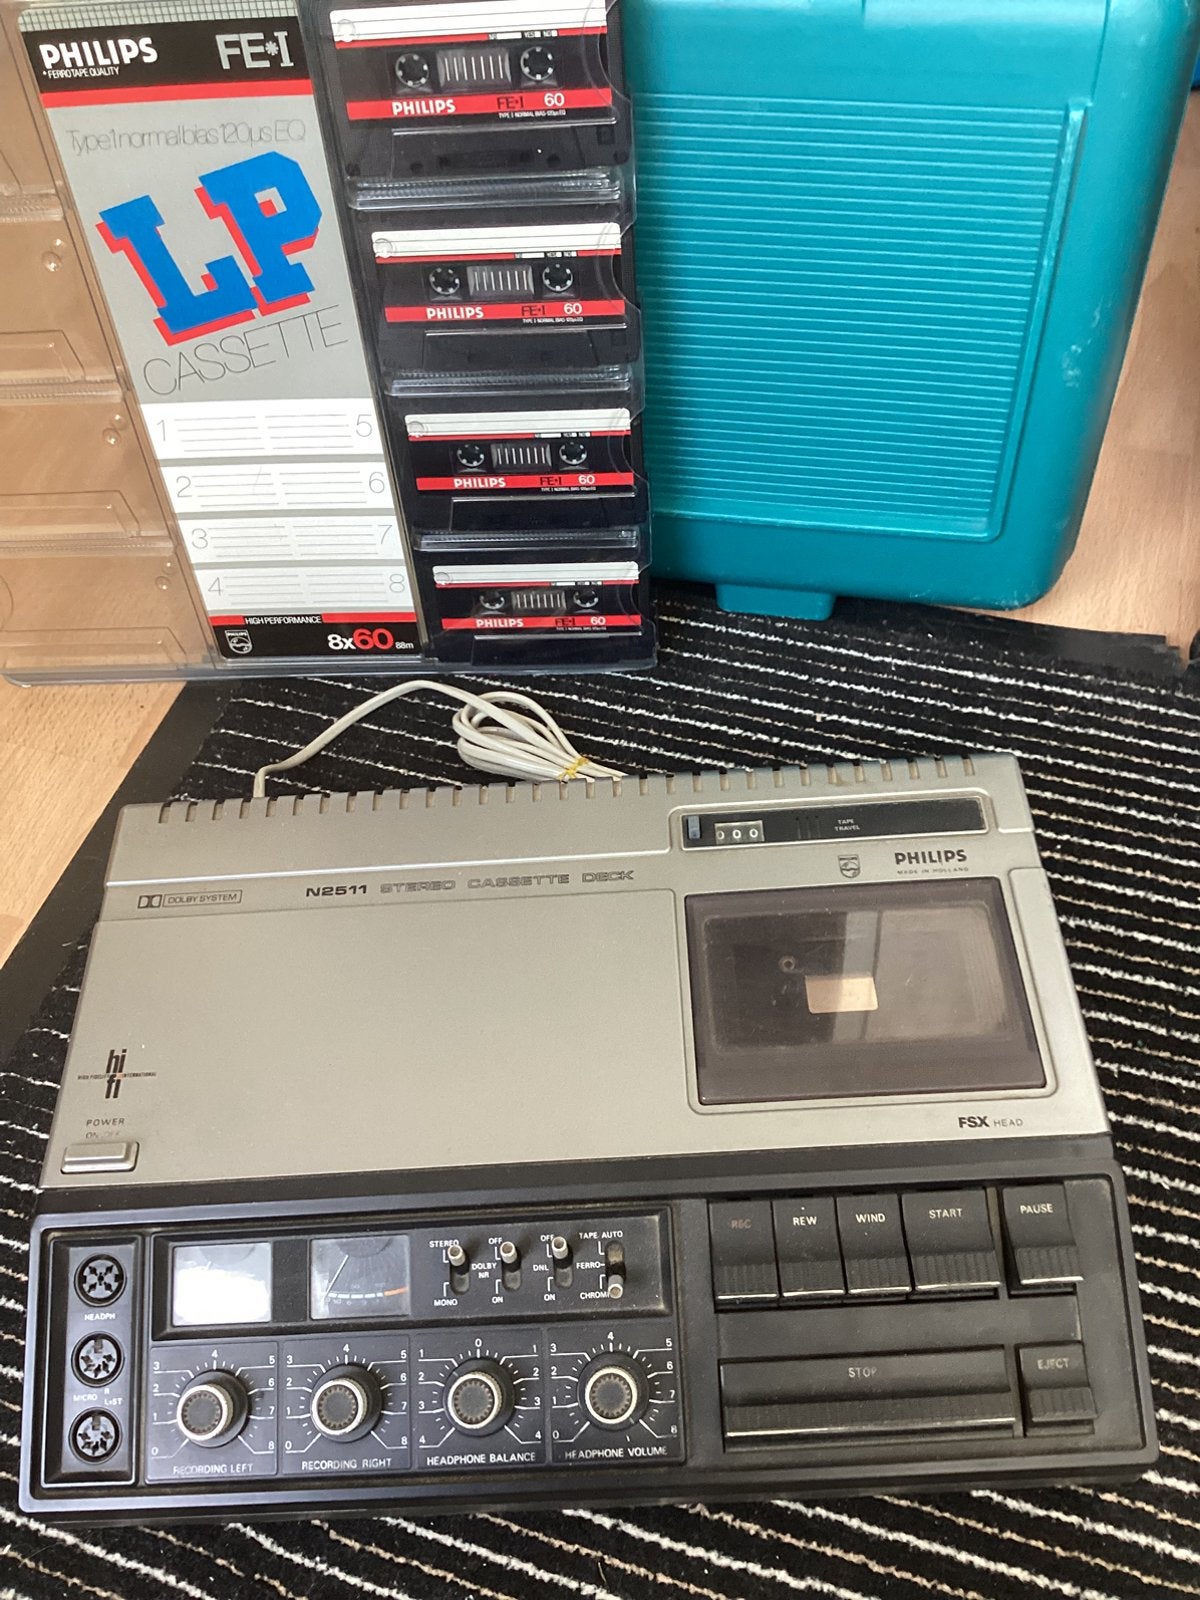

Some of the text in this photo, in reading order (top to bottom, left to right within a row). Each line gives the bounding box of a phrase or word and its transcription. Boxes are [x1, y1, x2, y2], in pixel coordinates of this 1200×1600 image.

[39, 37, 158, 69] PHILIPS
[72, 68, 89, 77] TAPE
[89, 66, 119, 76] QUALITY
[392, 99, 456, 116] PHILIPS
[544, 92, 565, 107] 60
[119, 125, 181, 148] normal
[182, 123, 219, 146] bias
[275, 119, 306, 142] EQ
[95, 151, 323, 346] LP
[427, 307, 484, 319] PHILIPS
[564, 303, 582, 314] 60
[143, 304, 348, 395] CASSETTE
[355, 414, 372, 437] 5
[156, 420, 166, 442] 1
[368, 472, 385, 494] 6
[454, 477, 506, 488] PHILIPS
[578, 475, 596, 485] 60
[176, 475, 192, 498] 2
[191, 528, 208, 549] 3
[378, 524, 393, 545] 7
[208, 576, 223, 596] 4
[390, 573, 406, 594] 8
[264, 616, 322, 624] PERFORMANCE
[476, 618, 524, 628] PHILIPS
[590, 616, 606, 626] 60
[395, 641, 414, 650] 88m
[834, 824, 860, 832] TRAVEL
[894, 849, 968, 865] PHILIPS
[306, 870, 634, 898] N2511 STEREO CASSETTE DECK
[168, 893, 237, 904] DOLBY SYSTEM
[106, 1048, 127, 1073] hi
[86, 1118, 125, 1127] POWER
[958, 1116, 1024, 1128] FSX HEAD
[1020, 1203, 1053, 1214] PAUSE
[856, 1212, 886, 1224] WIND
[928, 1208, 962, 1220] START
[731, 1219, 752, 1230] REC
[792, 1216, 817, 1226] REW
[540, 1234, 554, 1242] OFF
[579, 1232, 598, 1240] TAPE
[429, 1240, 459, 1248] STEREO
[488, 1237, 502, 1245] OFF
[472, 1262, 497, 1270] DOLBY
[533, 1264, 549, 1272] DNL
[492, 1296, 503, 1304] ON
[580, 1292, 610, 1300] CHROM
[84, 1312, 116, 1321] HEADPH
[608, 1332, 614, 1340] 4
[475, 1338, 482, 1348] 0
[666, 1338, 672, 1347] 5
[343, 1344, 350, 1352] 4
[550, 1344, 556, 1352] 3
[212, 1350, 218, 1358] 4
[400, 1350, 406, 1359] 5
[269, 1356, 275, 1364] 5
[286, 1356, 292, 1364] 3
[1037, 1358, 1070, 1369] EJECT
[153, 1362, 160, 1370] 3
[666, 1361, 672, 1370] 6
[532, 1368, 539, 1376] 2
[551, 1366, 557, 1376] 2
[848, 1366, 878, 1378] STOP
[400, 1373, 406, 1382] 6
[418, 1372, 424, 1380] 2
[268, 1378, 274, 1386] 6
[286, 1378, 292, 1386] 2
[153, 1384, 160, 1392] 2
[73, 1394, 98, 1402] MICRO
[670, 1390, 675, 1398] 7
[418, 1401, 424, 1410] 3
[534, 1396, 540, 1406] 3
[269, 1406, 274, 1415] 7
[402, 1402, 407, 1410] 7
[671, 1425, 677, 1434] 8
[535, 1430, 542, 1440] 4
[552, 1430, 559, 1440] 0
[401, 1436, 408, 1445] 8
[418, 1436, 426, 1444] 4
[268, 1442, 274, 1450] 8
[285, 1440, 292, 1450] 0
[152, 1447, 158, 1456] 0
[565, 1446, 668, 1459] HEADPHONE VOLUME
[427, 1452, 536, 1466] HEADPHONE BALANCE
[173, 1463, 254, 1474] RECORDING LEFT
[302, 1458, 392, 1470] RECORDING RIGHT
